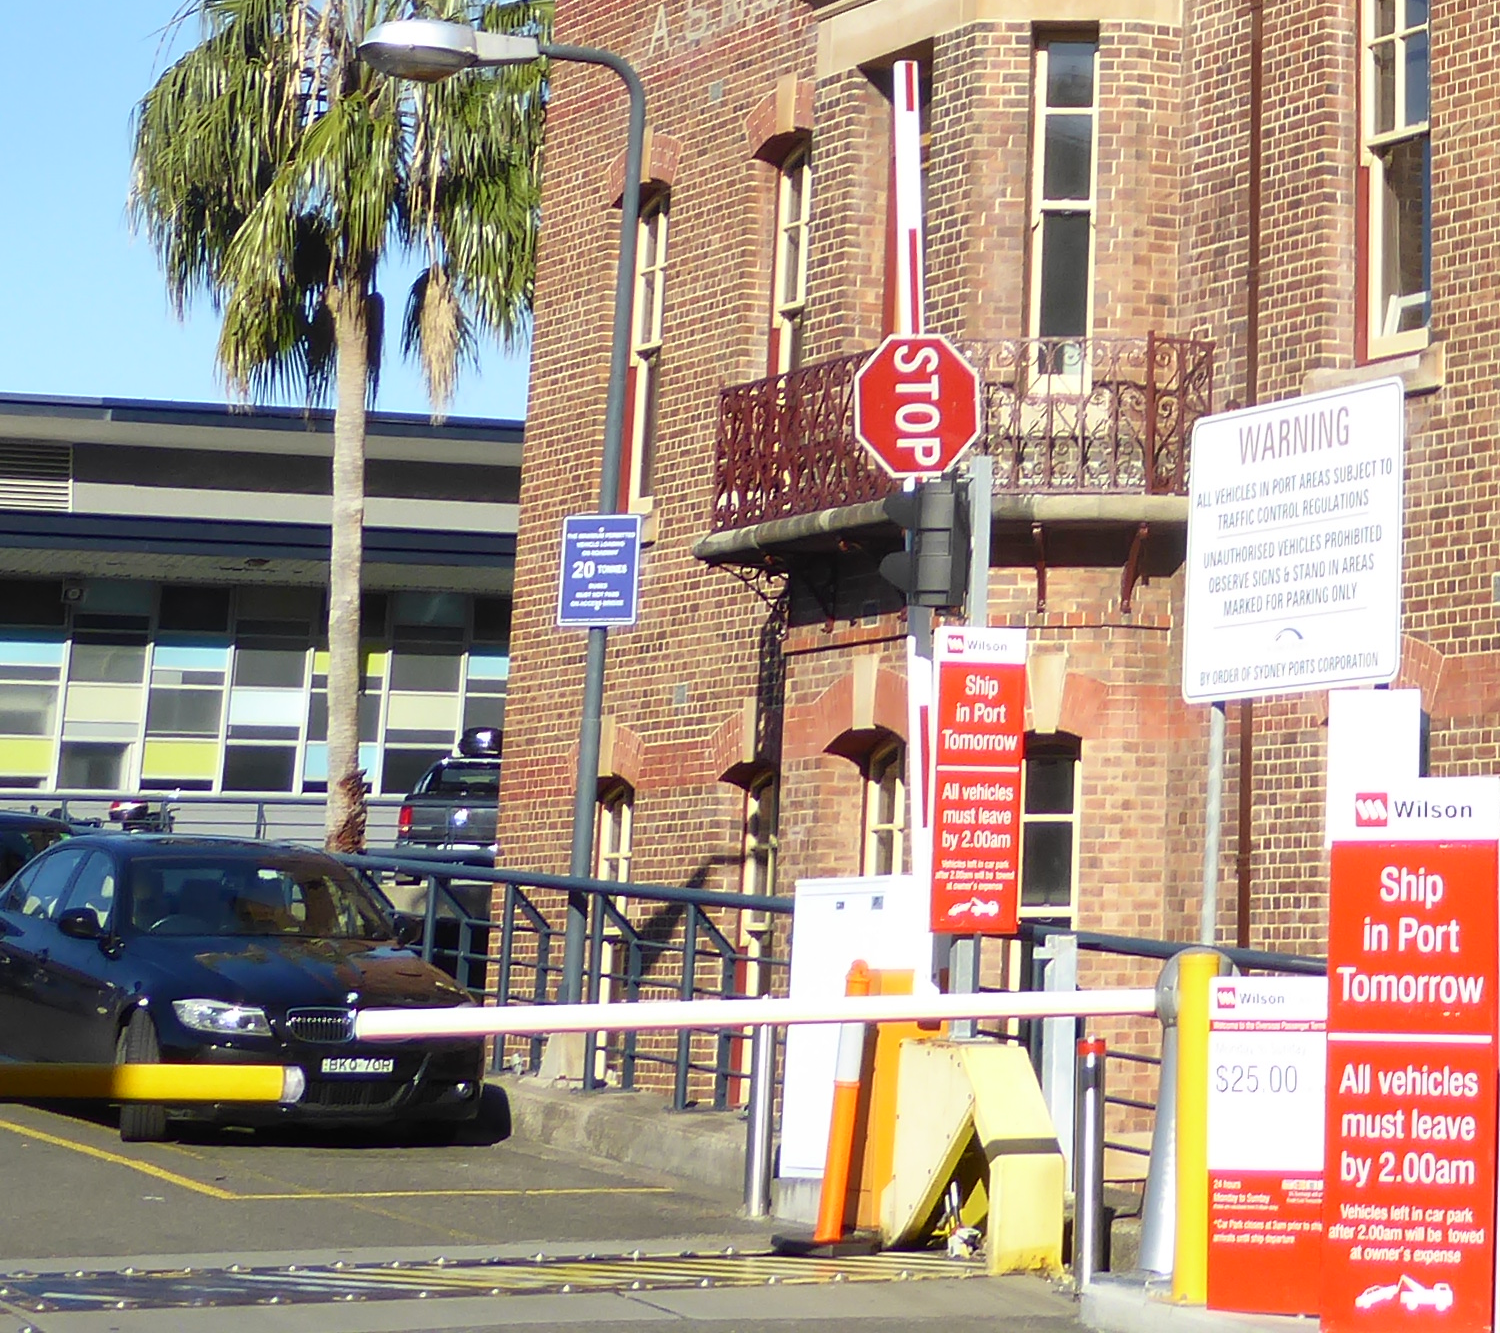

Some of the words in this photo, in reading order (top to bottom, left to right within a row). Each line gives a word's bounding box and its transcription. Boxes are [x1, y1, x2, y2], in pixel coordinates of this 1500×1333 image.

[893, 345, 941, 466] STOP
[1239, 406, 1349, 465] WARNING
[1196, 492, 1212, 509] ALL
[1214, 482, 1257, 505] VEHICLES
[1259, 480, 1269, 497] IN
[1272, 474, 1297, 496] PORT
[1299, 468, 1331, 490] AREAS
[1333, 460, 1377, 484] SUBJECT
[1380, 457, 1393, 476] TO
[1218, 509, 1255, 530] TRAFFIC
[1257, 502, 1300, 524] CONTROL
[1302, 488, 1369, 516] REGULATIONS
[1203, 542, 1275, 569] UNAUTHORISED
[1277, 533, 1321, 556] VEHICLES
[1324, 524, 1382, 550] PROHIBITED
[571, 561, 596, 579] 20
[1208, 571, 1250, 593] OBSERVE
[1252, 567, 1281, 588] SIGNS
[1283, 566, 1290, 583] &
[1293, 560, 1326, 582] STAND
[1328, 559, 1339, 576] IN
[1342, 553, 1375, 574] AREAS
[1223, 596, 1263, 617] MARKED
[1266, 593, 1284, 611] FOR
[1286, 586, 1329, 608] PARKING
[1331, 582, 1358, 603] ONLY
[967, 640, 1008, 651] Wilson
[1200, 671, 1211, 687] BY
[1212, 667, 1239, 685] ORDER
[1241, 666, 1252, 681] OF
[1253, 662, 1286, 680] SYDNEY
[1288, 659, 1315, 677] PORTS
[1317, 651, 1379, 674] CORPORATION
[965, 674, 999, 699] Ship
[955, 702, 970, 722] in
[974, 702, 1006, 723] Port
[942, 729, 1018, 751] Tomorrow
[942, 782, 959, 801] All
[962, 783, 1014, 801] vehicles
[943, 807, 976, 824] must
[978, 807, 1012, 825] leave
[1394, 800, 1472, 819] Wilson
[942, 830, 958, 851] by
[961, 830, 1011, 849] 2.00am
[1379, 866, 1444, 910] Ship
[1363, 916, 1389, 952] in
[1398, 916, 1460, 953] Port
[1239, 993, 1285, 1004] Wilson
[1336, 966, 1484, 1004] Tomorrow
[1216, 1064, 1298, 1093] $25.00
[1339, 1063, 1371, 1094] All
[1378, 1065, 1479, 1097] vehicles
[1341, 1109, 1404, 1139] must
[1411, 1108, 1476, 1141] leave
[1340, 1150, 1372, 1188] by
[1378, 1151, 1475, 1184] 2.00am
[1340, 1203, 1388, 1220] Vehicles
[1390, 1205, 1409, 1221] left
[1411, 1206, 1423, 1221] in
[1425, 1208, 1445, 1222] car
[1447, 1208, 1473, 1225] park
[1328, 1224, 1356, 1239] after
[1357, 1225, 1401, 1241] 2.00am
[1404, 1227, 1424, 1242] will
[1426, 1227, 1442, 1242] be
[1447, 1227, 1485, 1244] towed
[1350, 1246, 1362, 1260] at
[1364, 1246, 1411, 1262] owner's
[1413, 1248, 1461, 1265] expense
